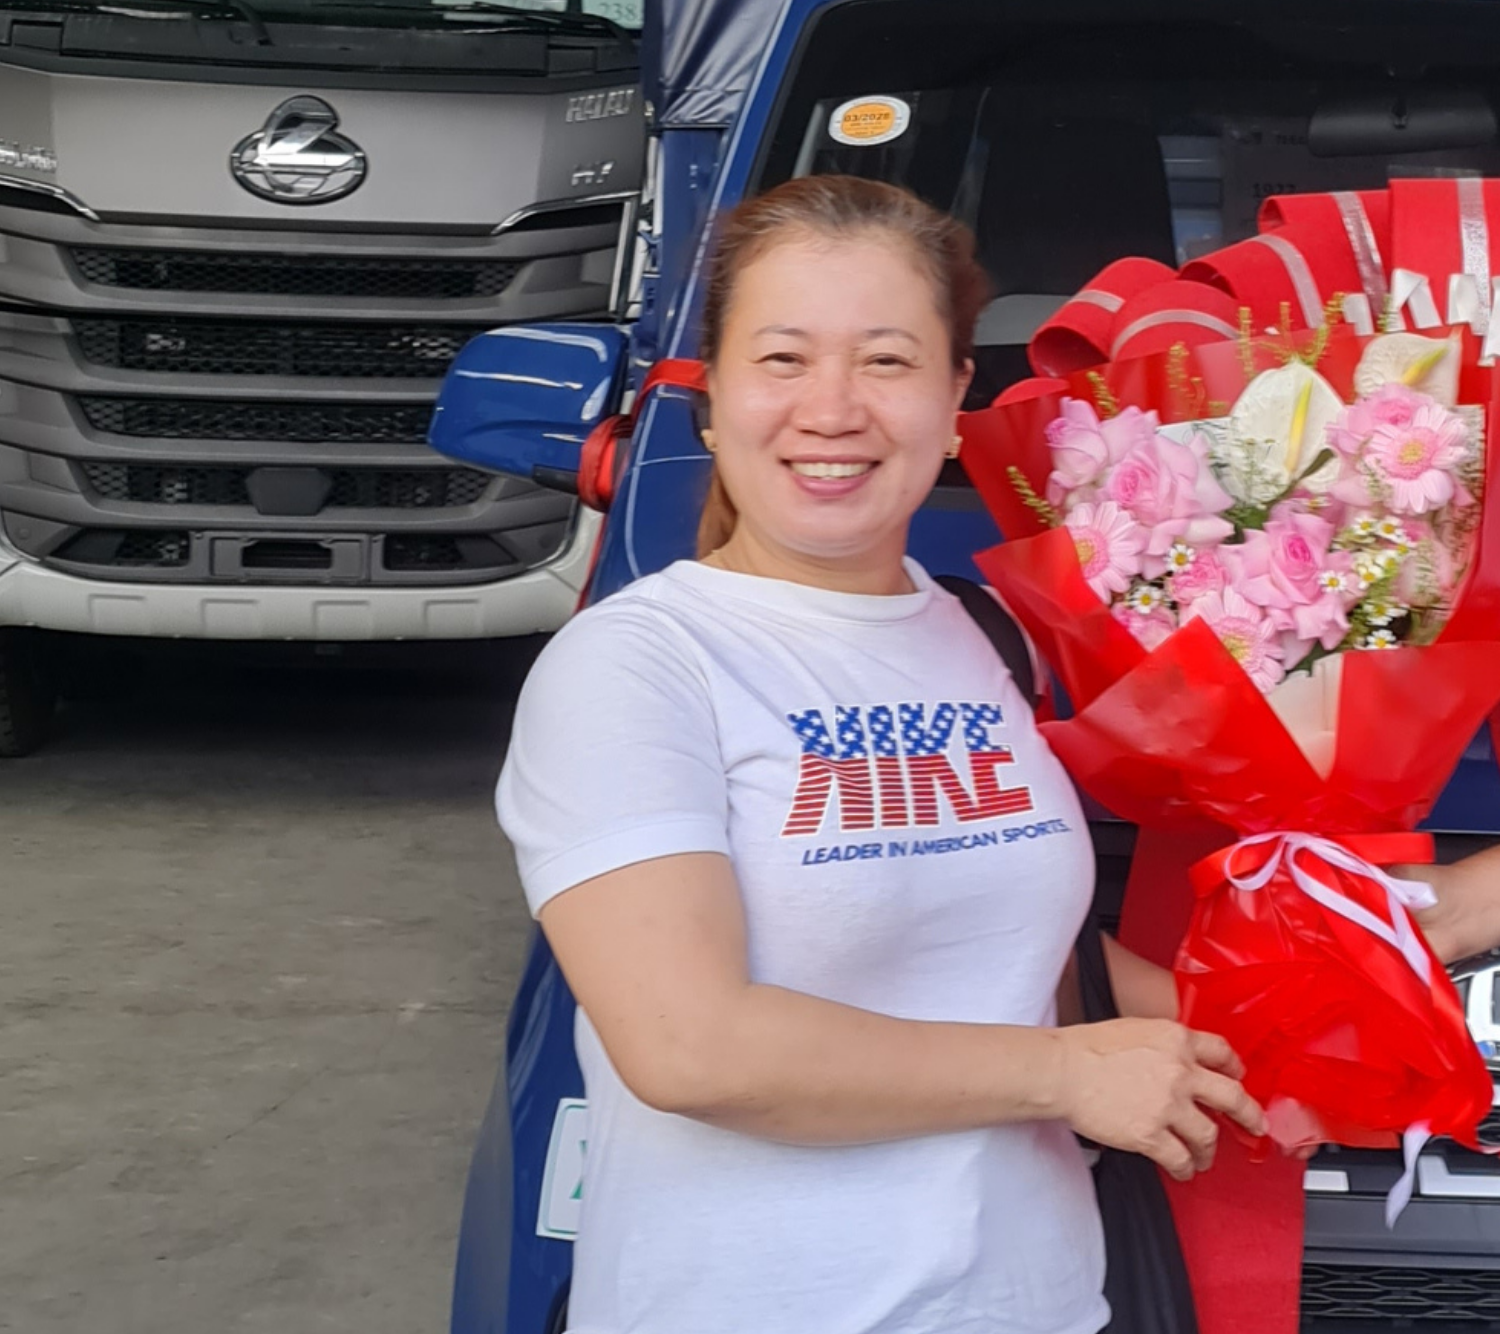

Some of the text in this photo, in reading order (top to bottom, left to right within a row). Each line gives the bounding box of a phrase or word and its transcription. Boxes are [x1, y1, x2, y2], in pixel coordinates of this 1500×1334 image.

[779, 701, 1036, 839] NIKE
[802, 842, 883, 866] LEADER
[888, 839, 910, 858] IN
[910, 830, 998, 856] AMERICAN
